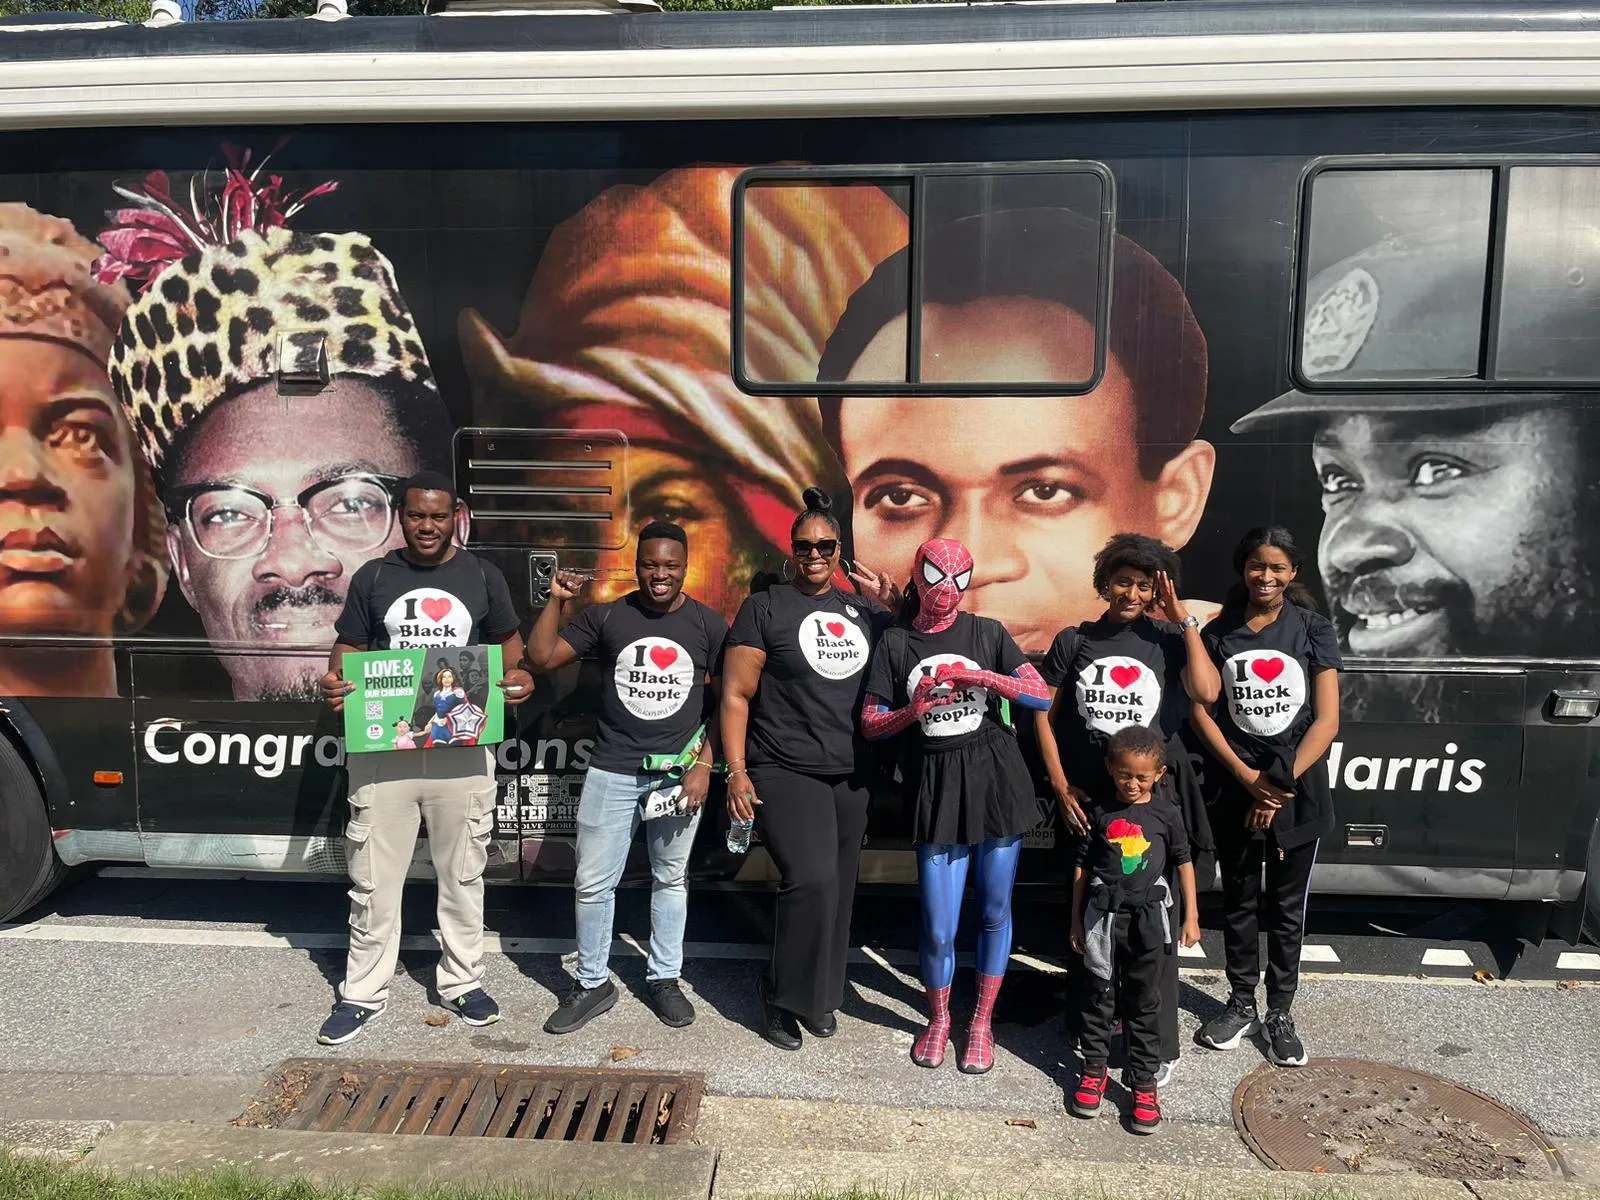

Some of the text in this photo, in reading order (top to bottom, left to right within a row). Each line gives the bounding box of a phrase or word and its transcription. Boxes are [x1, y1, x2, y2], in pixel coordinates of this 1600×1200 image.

[403, 598, 418, 620] I
[398, 624, 457, 638] Black
[814, 618, 827, 637] I
[815, 638, 856, 648] Black
[633, 645, 647, 667] I
[817, 650, 860, 661] People
[364, 658, 414, 678] LOVE &
[1092, 664, 1107, 685] I
[1234, 659, 1249, 682] I
[365, 675, 414, 690] PROTECT
[628, 670, 682, 685] Black
[365, 688, 414, 698] OUR CHILDREN
[628, 686, 681, 702] People
[1084, 689, 1144, 706] Black
[1231, 685, 1291, 700] Black
[923, 706, 978, 725] People
[1085, 706, 1142, 723] People
[1234, 702, 1290, 718] People
